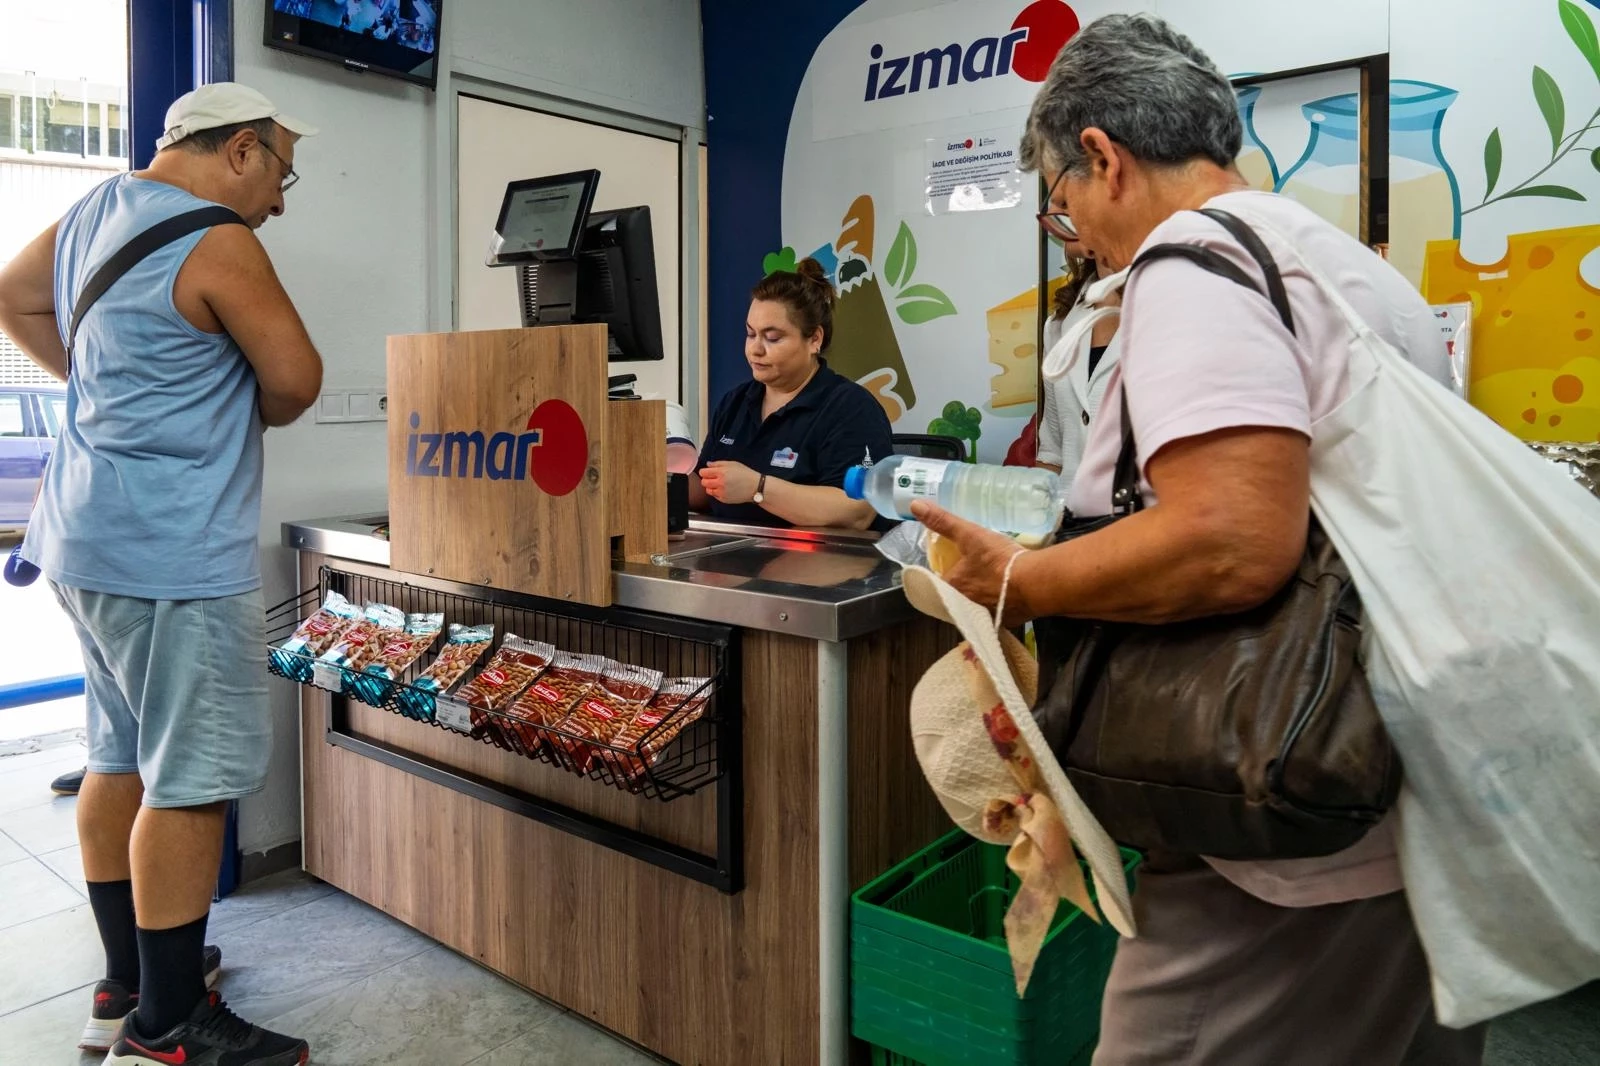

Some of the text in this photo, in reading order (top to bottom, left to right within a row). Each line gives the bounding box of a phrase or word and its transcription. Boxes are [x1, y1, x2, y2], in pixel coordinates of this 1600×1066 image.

[864, 29, 1027, 102] izmar
[932, 160, 946, 168] İADE
[955, 155, 980, 165] DEĞİŞİM
[980, 150, 1013, 161] POLİTİKASI
[947, 142, 967, 151] izma
[405, 411, 540, 481] izmar
